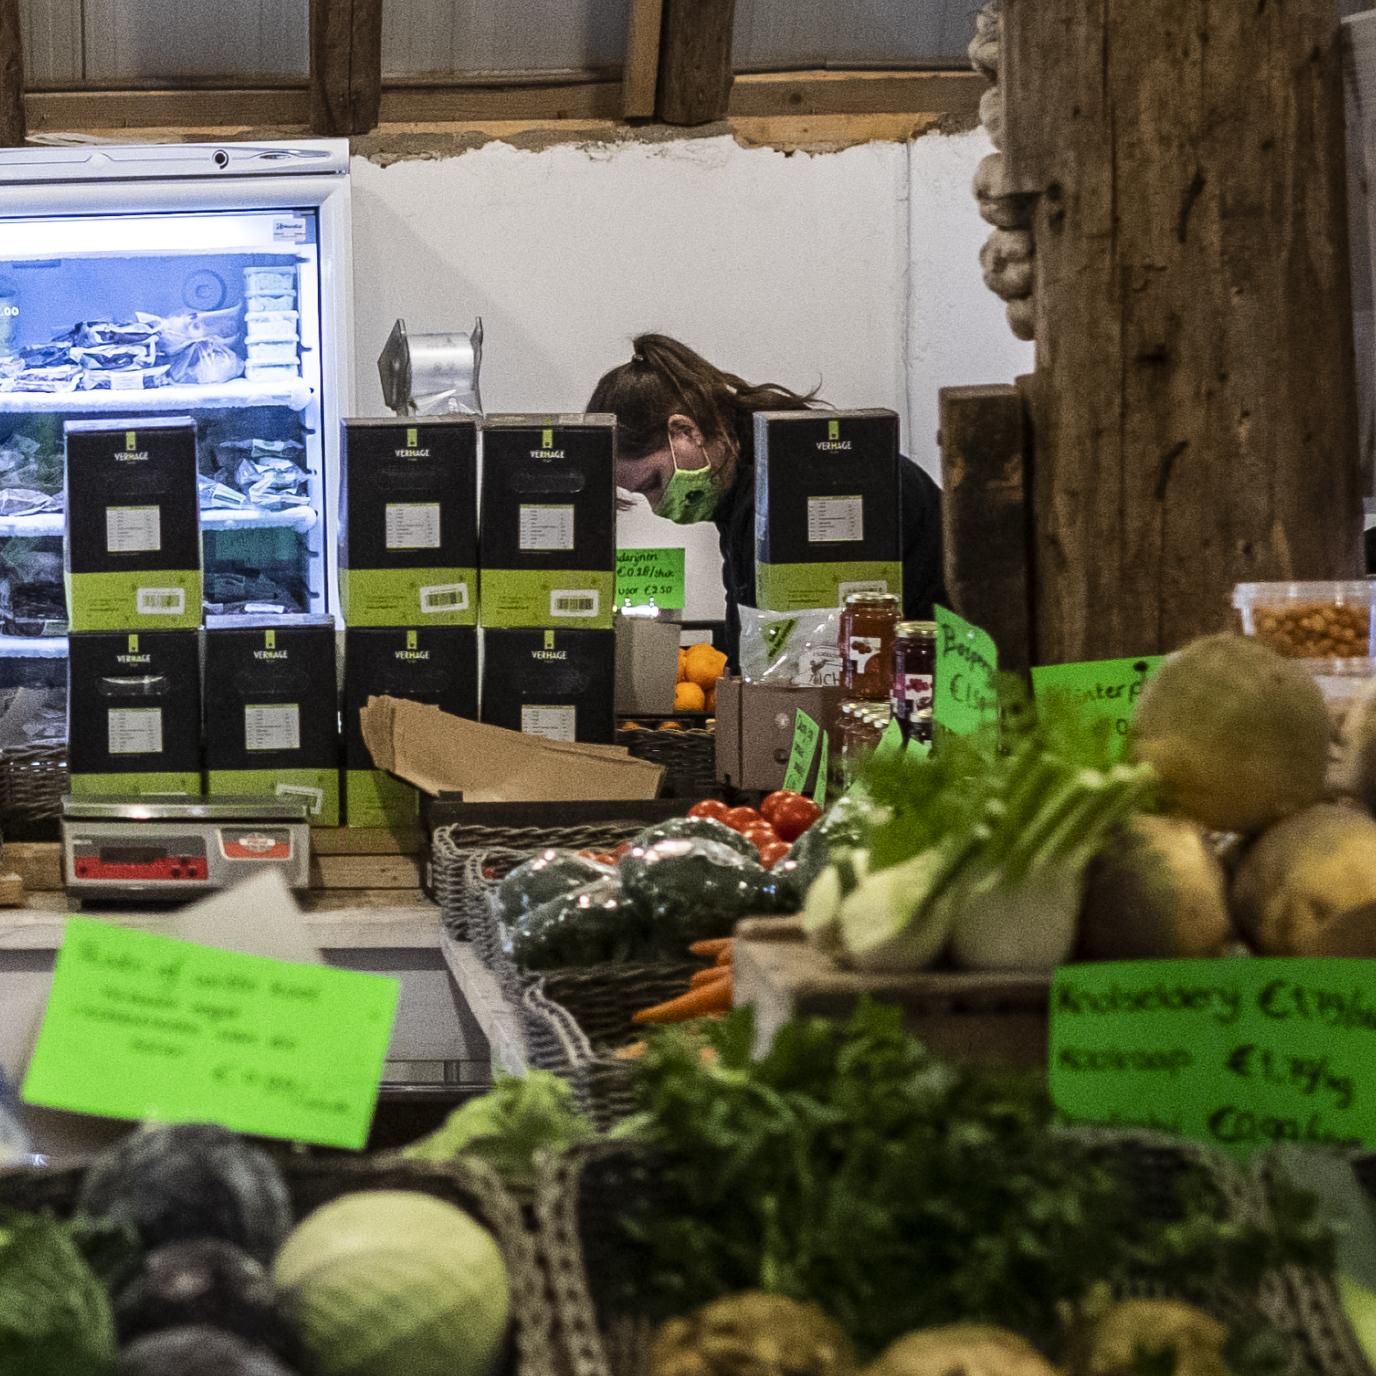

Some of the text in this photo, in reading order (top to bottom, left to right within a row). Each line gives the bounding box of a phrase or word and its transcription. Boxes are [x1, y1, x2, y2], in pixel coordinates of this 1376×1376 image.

[815, 440, 853, 451] VERHAGE
[113, 451, 149, 462] VERHAGE
[394, 448, 430, 458] VERHAGE
[529, 450, 565, 460] VERHAGE
[116, 653, 152, 664] VERHAGE
[253, 650, 289, 660] VERHAGE
[394, 650, 430, 660] VERHAGE
[531, 650, 568, 661] VERHAGE
